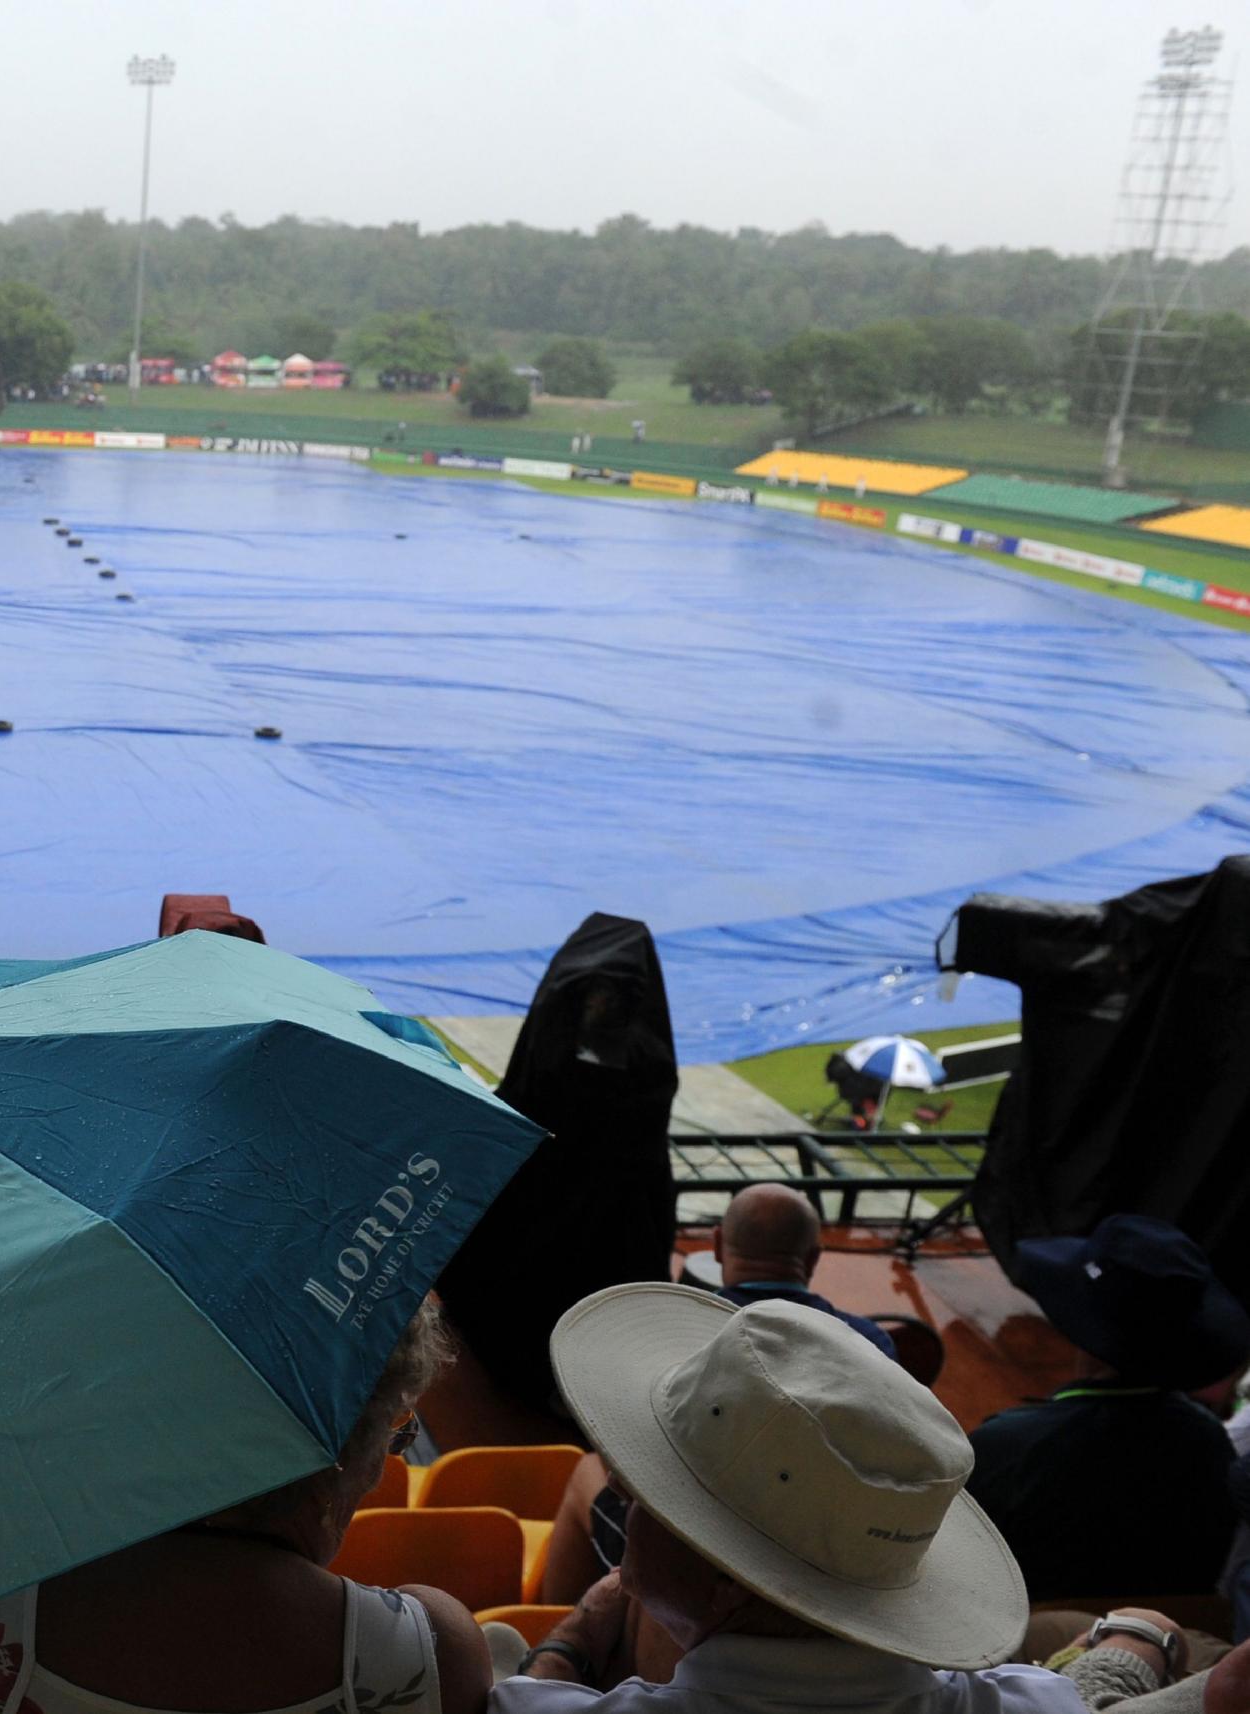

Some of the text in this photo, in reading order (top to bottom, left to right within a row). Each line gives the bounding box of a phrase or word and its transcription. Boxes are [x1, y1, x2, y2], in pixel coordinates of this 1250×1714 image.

[350, 1182, 454, 1331] THE HOME OF CRICKET
